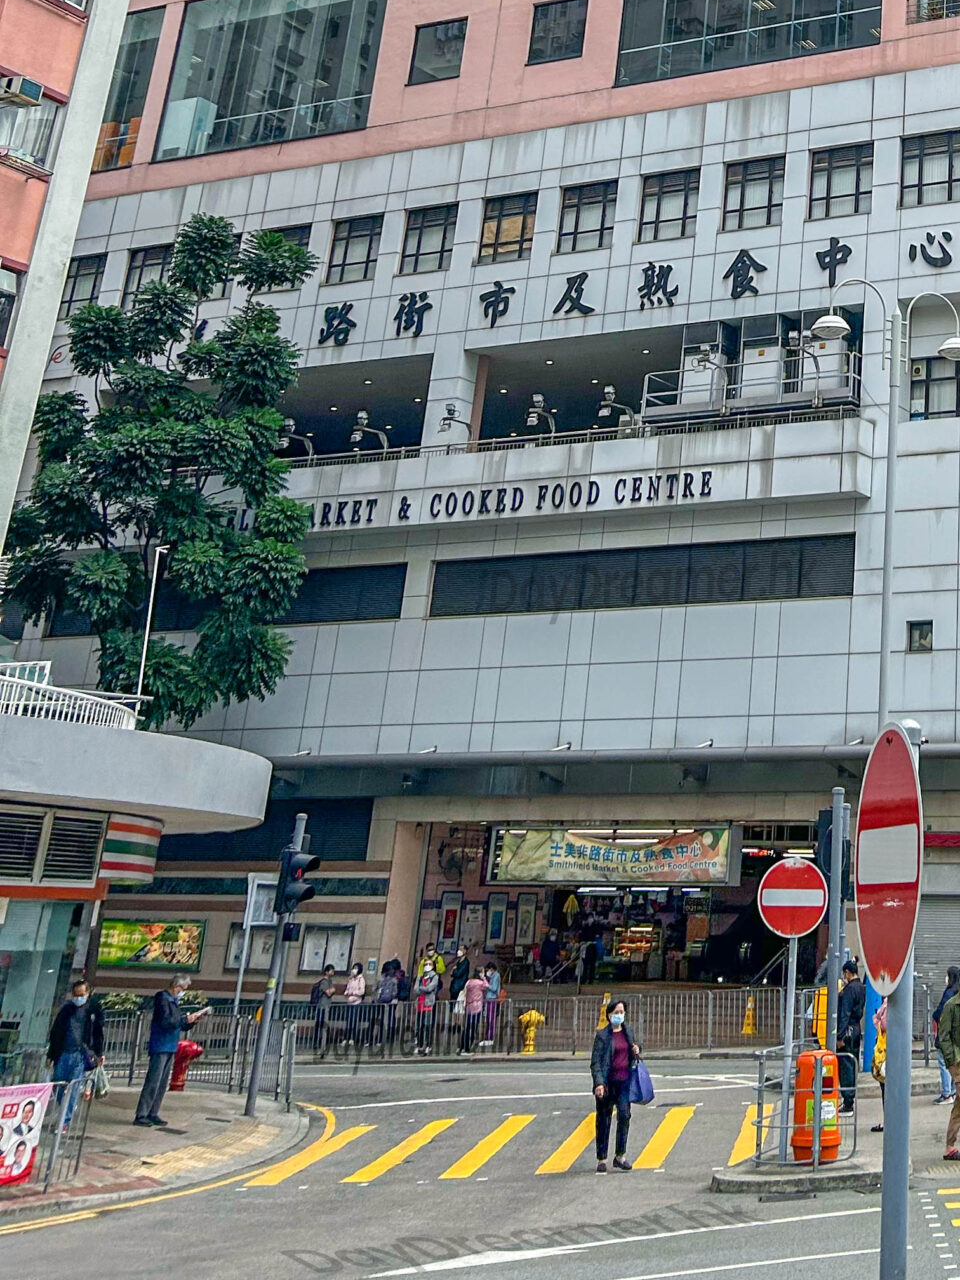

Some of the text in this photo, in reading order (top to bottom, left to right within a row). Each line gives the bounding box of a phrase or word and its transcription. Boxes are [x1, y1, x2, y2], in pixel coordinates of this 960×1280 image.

[398, 495, 411, 521] &
[430, 486, 525, 518] COOKED
[536, 479, 601, 511] FOOD
[614, 471, 713, 505] CENTRE
[548, 859, 590, 871] Smithfield
[592, 862, 620, 874] Market
[630, 861, 666, 874] Cooked
[667, 861, 689, 871] Food
[690, 858, 718, 869] Centre
